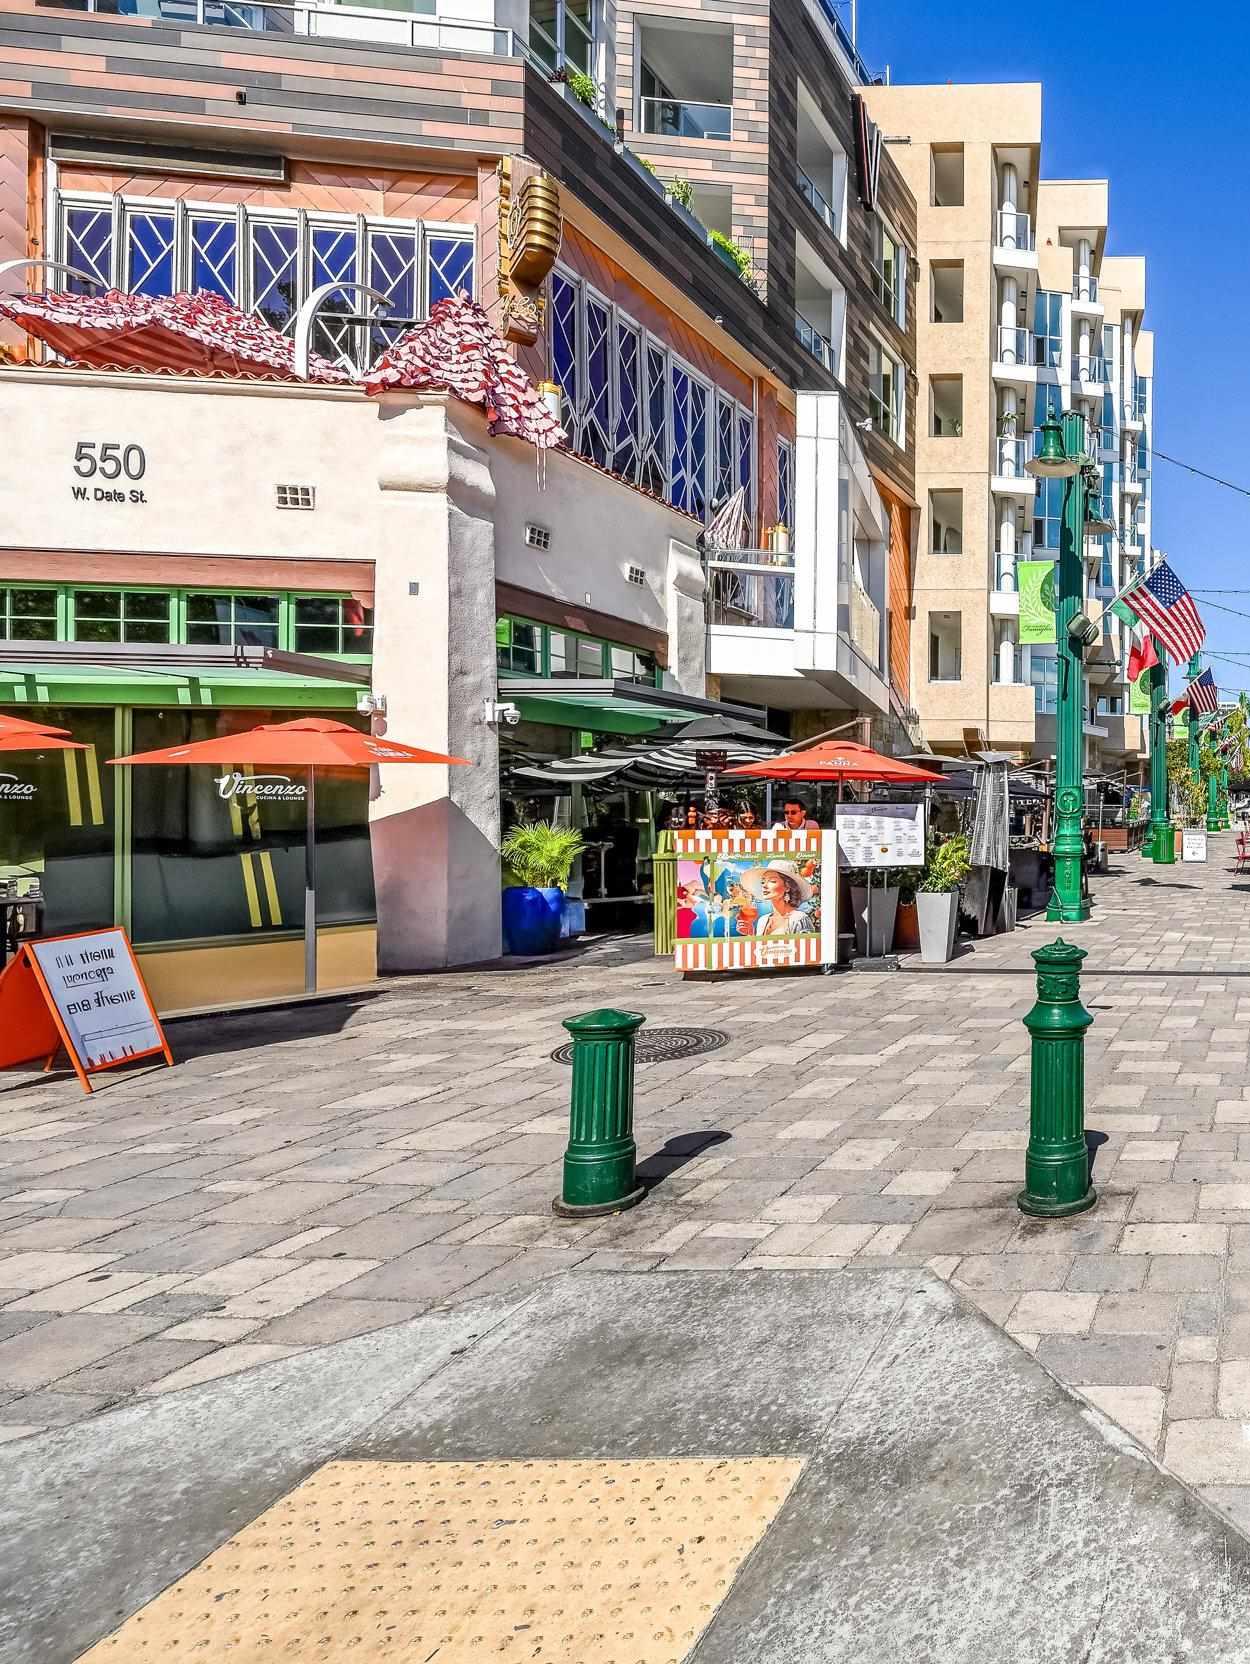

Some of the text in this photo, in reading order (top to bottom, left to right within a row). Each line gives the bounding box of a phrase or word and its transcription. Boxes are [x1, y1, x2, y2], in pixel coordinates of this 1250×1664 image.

[73, 441, 146, 480] 550
[71, 486, 148, 503] W. Date St.
[214, 772, 308, 799] Vincenzo
